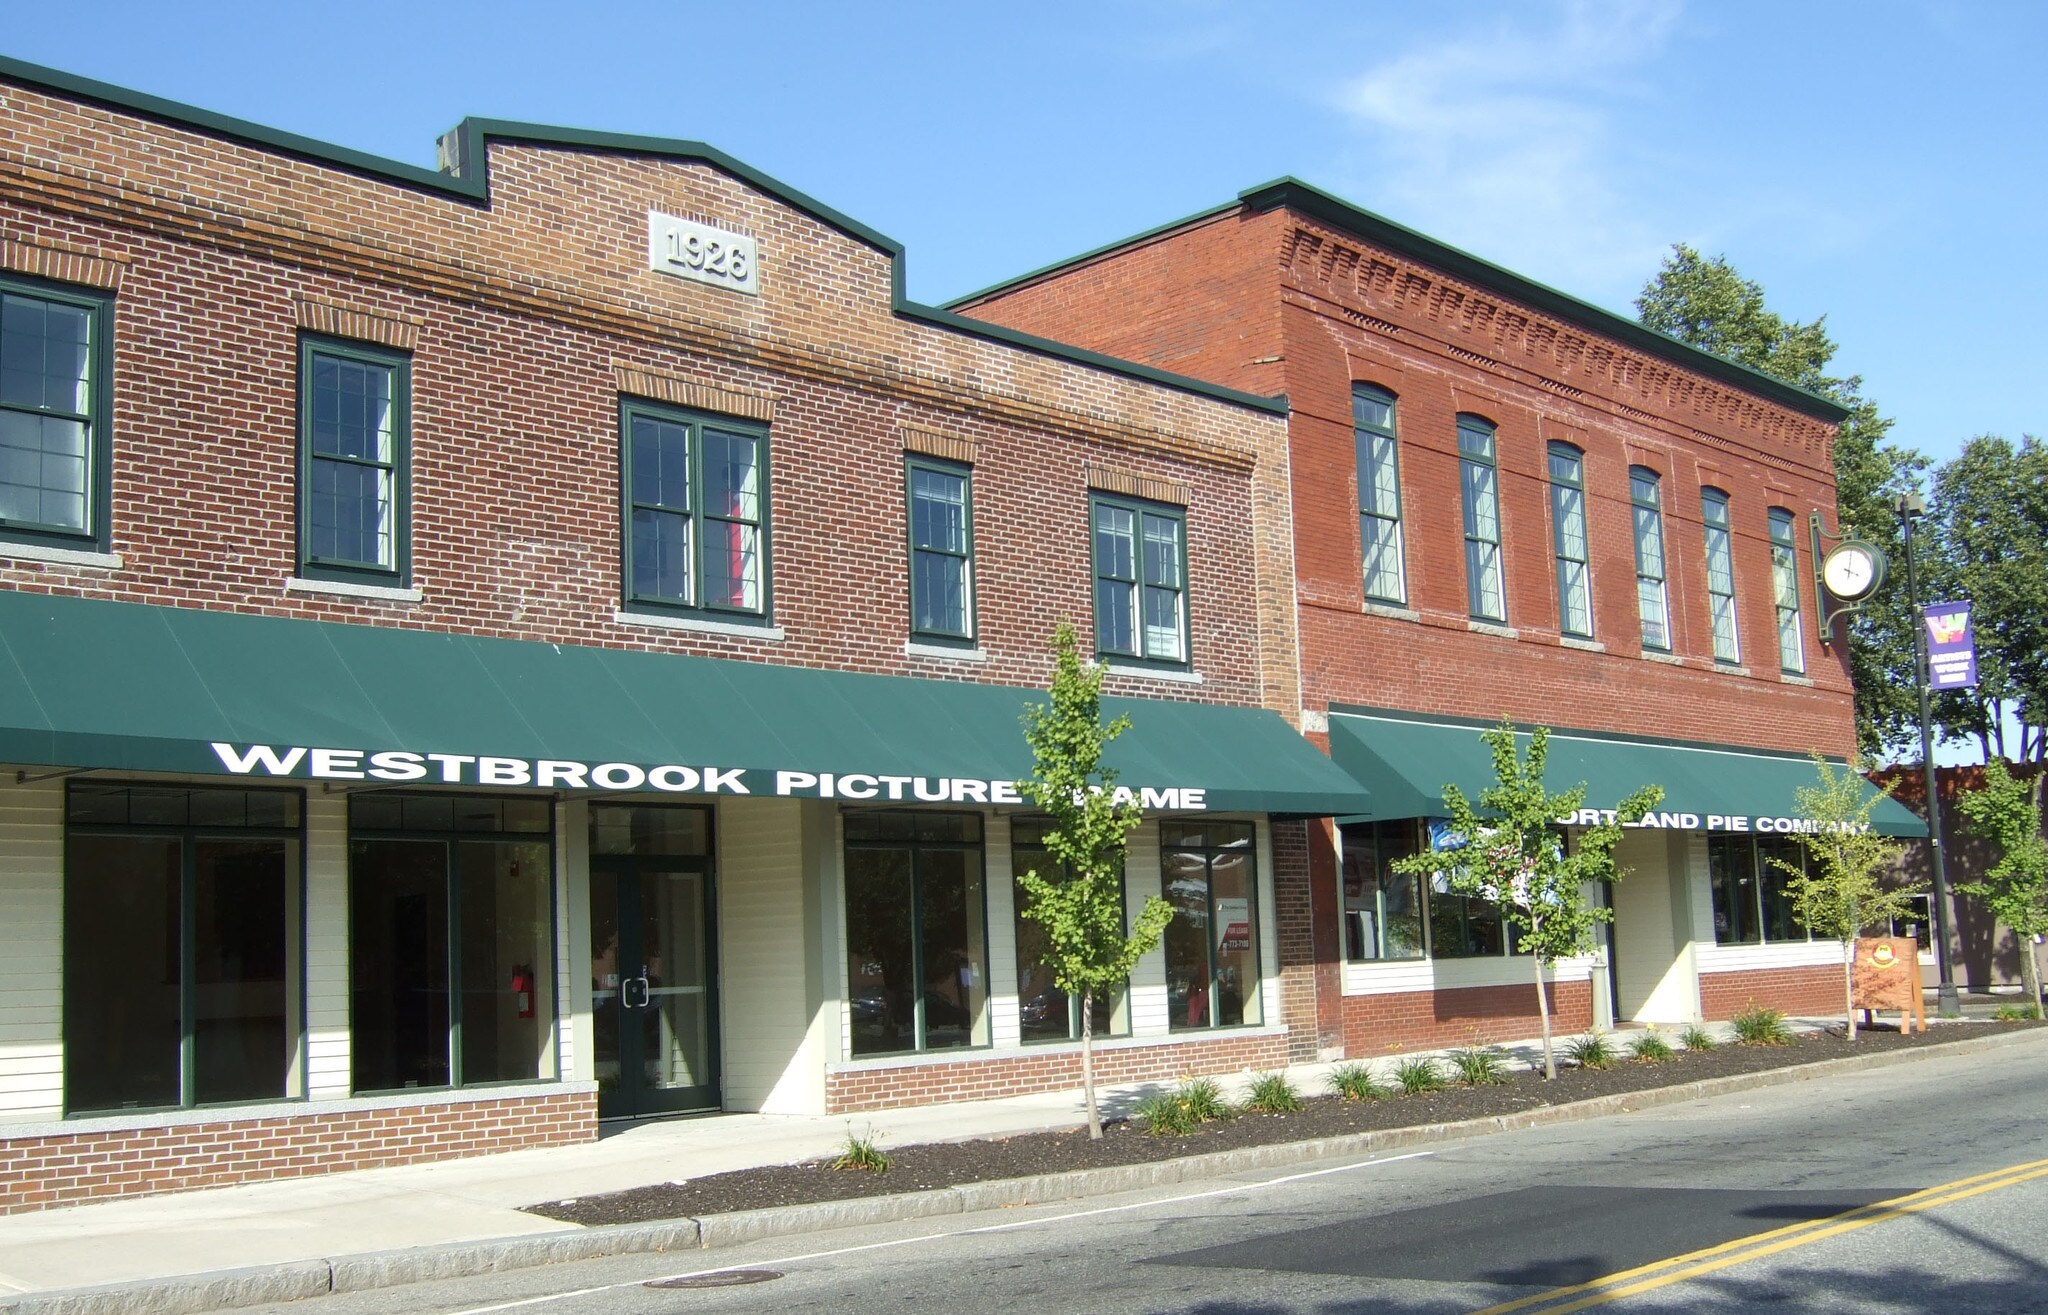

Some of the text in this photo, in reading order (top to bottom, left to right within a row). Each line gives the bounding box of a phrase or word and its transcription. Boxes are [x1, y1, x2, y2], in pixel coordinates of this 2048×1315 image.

[666, 227, 747, 280] 1926
[211, 742, 1207, 810] WESTBROOK PICTURE RAME
[1708, 815, 1749, 832] PIE
